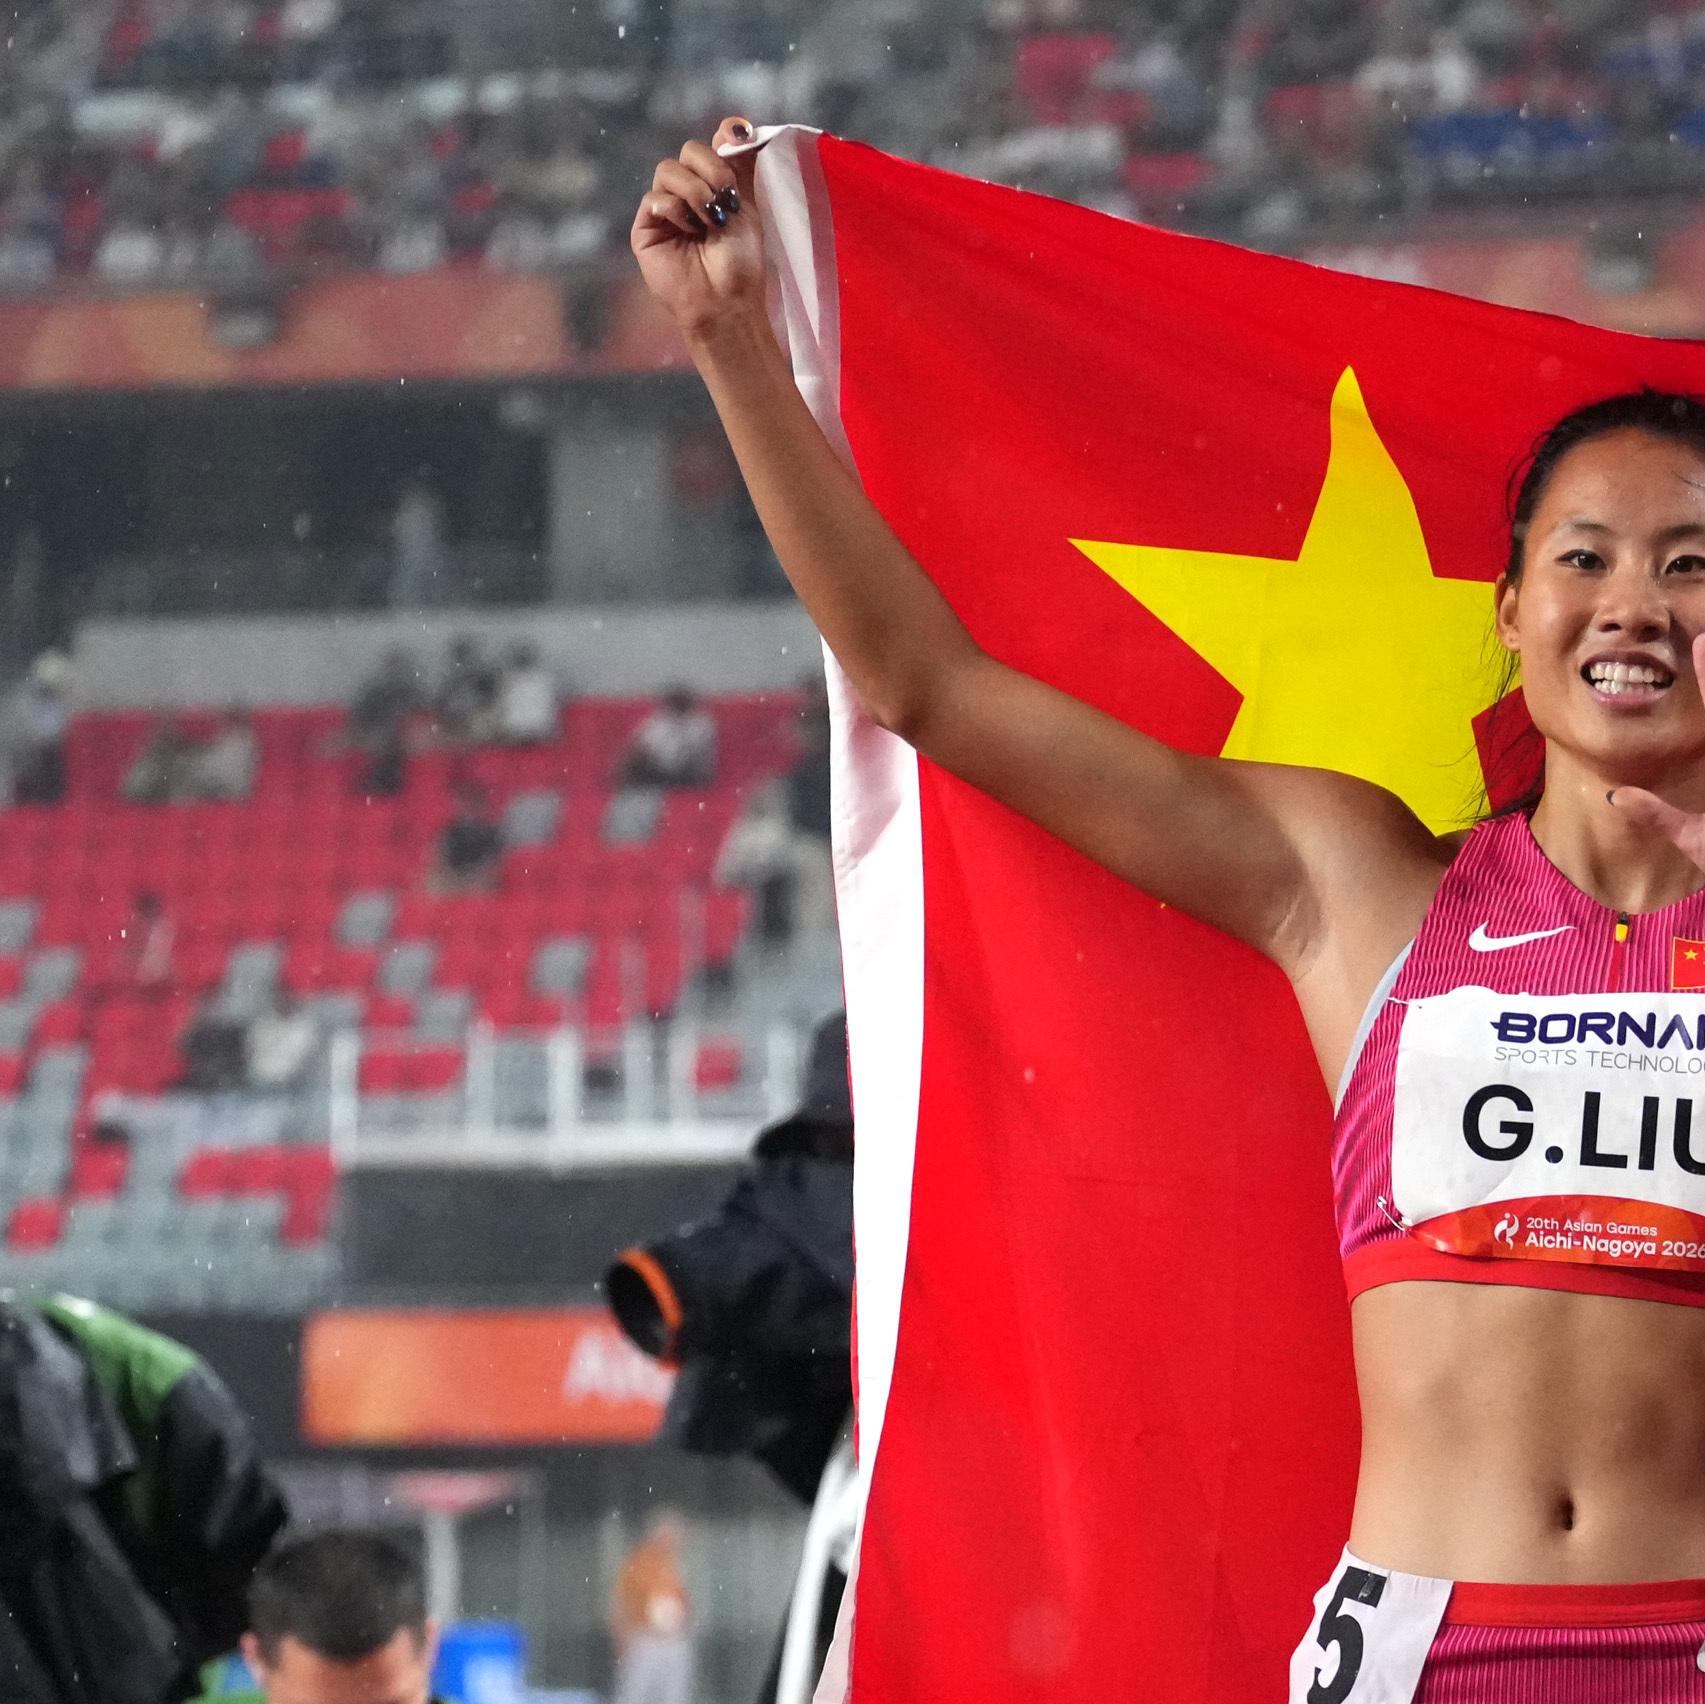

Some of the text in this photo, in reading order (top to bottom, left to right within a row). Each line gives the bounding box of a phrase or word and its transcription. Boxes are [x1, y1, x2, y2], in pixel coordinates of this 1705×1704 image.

[1494, 1047, 1577, 1066] SPORTS
[1526, 1217, 1658, 1237] 20th Asian Games
[1524, 1232, 1657, 1258] Aichi-Nagoya
